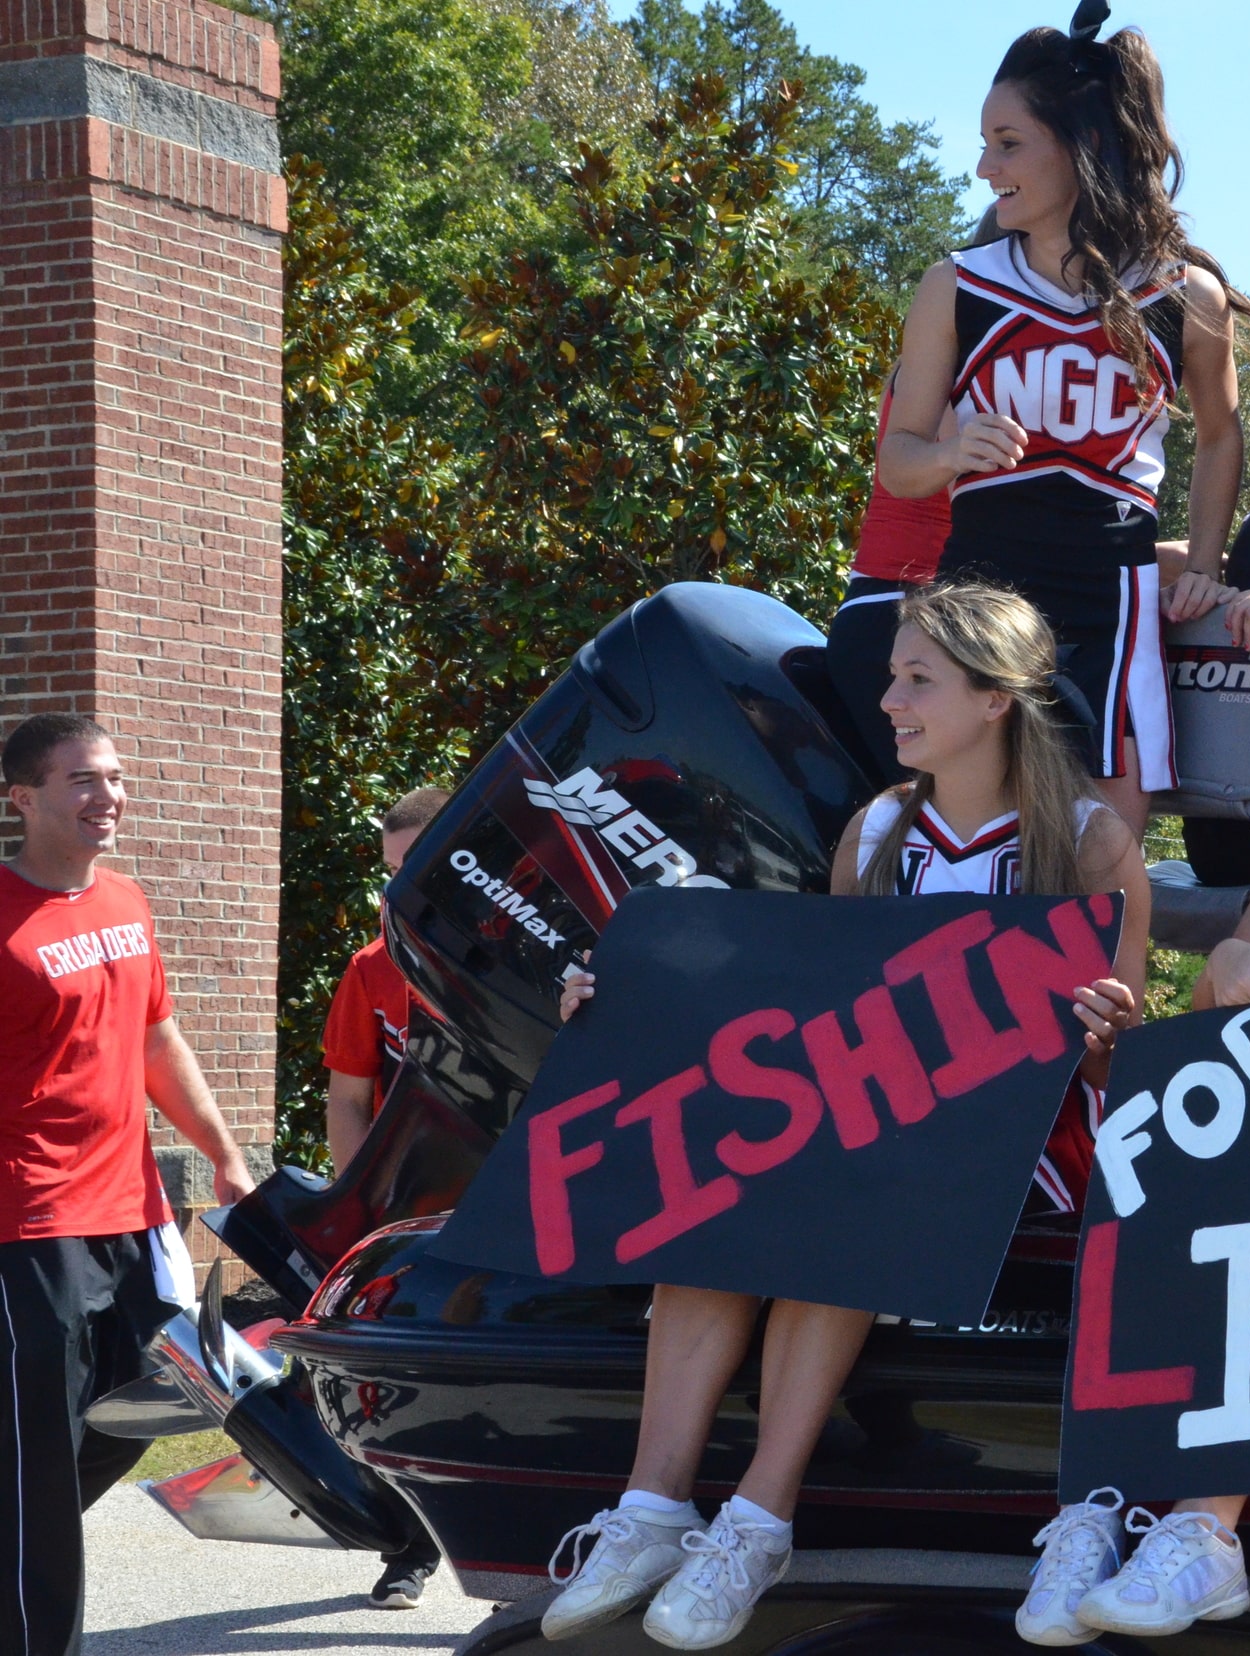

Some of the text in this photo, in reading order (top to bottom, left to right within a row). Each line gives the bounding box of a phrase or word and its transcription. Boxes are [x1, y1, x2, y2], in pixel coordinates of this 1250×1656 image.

[993, 341, 1142, 444] NGC
[553, 766, 731, 887] MER
[36, 922, 150, 979] CRUSADERS
[449, 849, 567, 950] OptiMax
[527, 893, 1115, 1277] FISHIN'
[957, 1309, 1052, 1334] OATS
